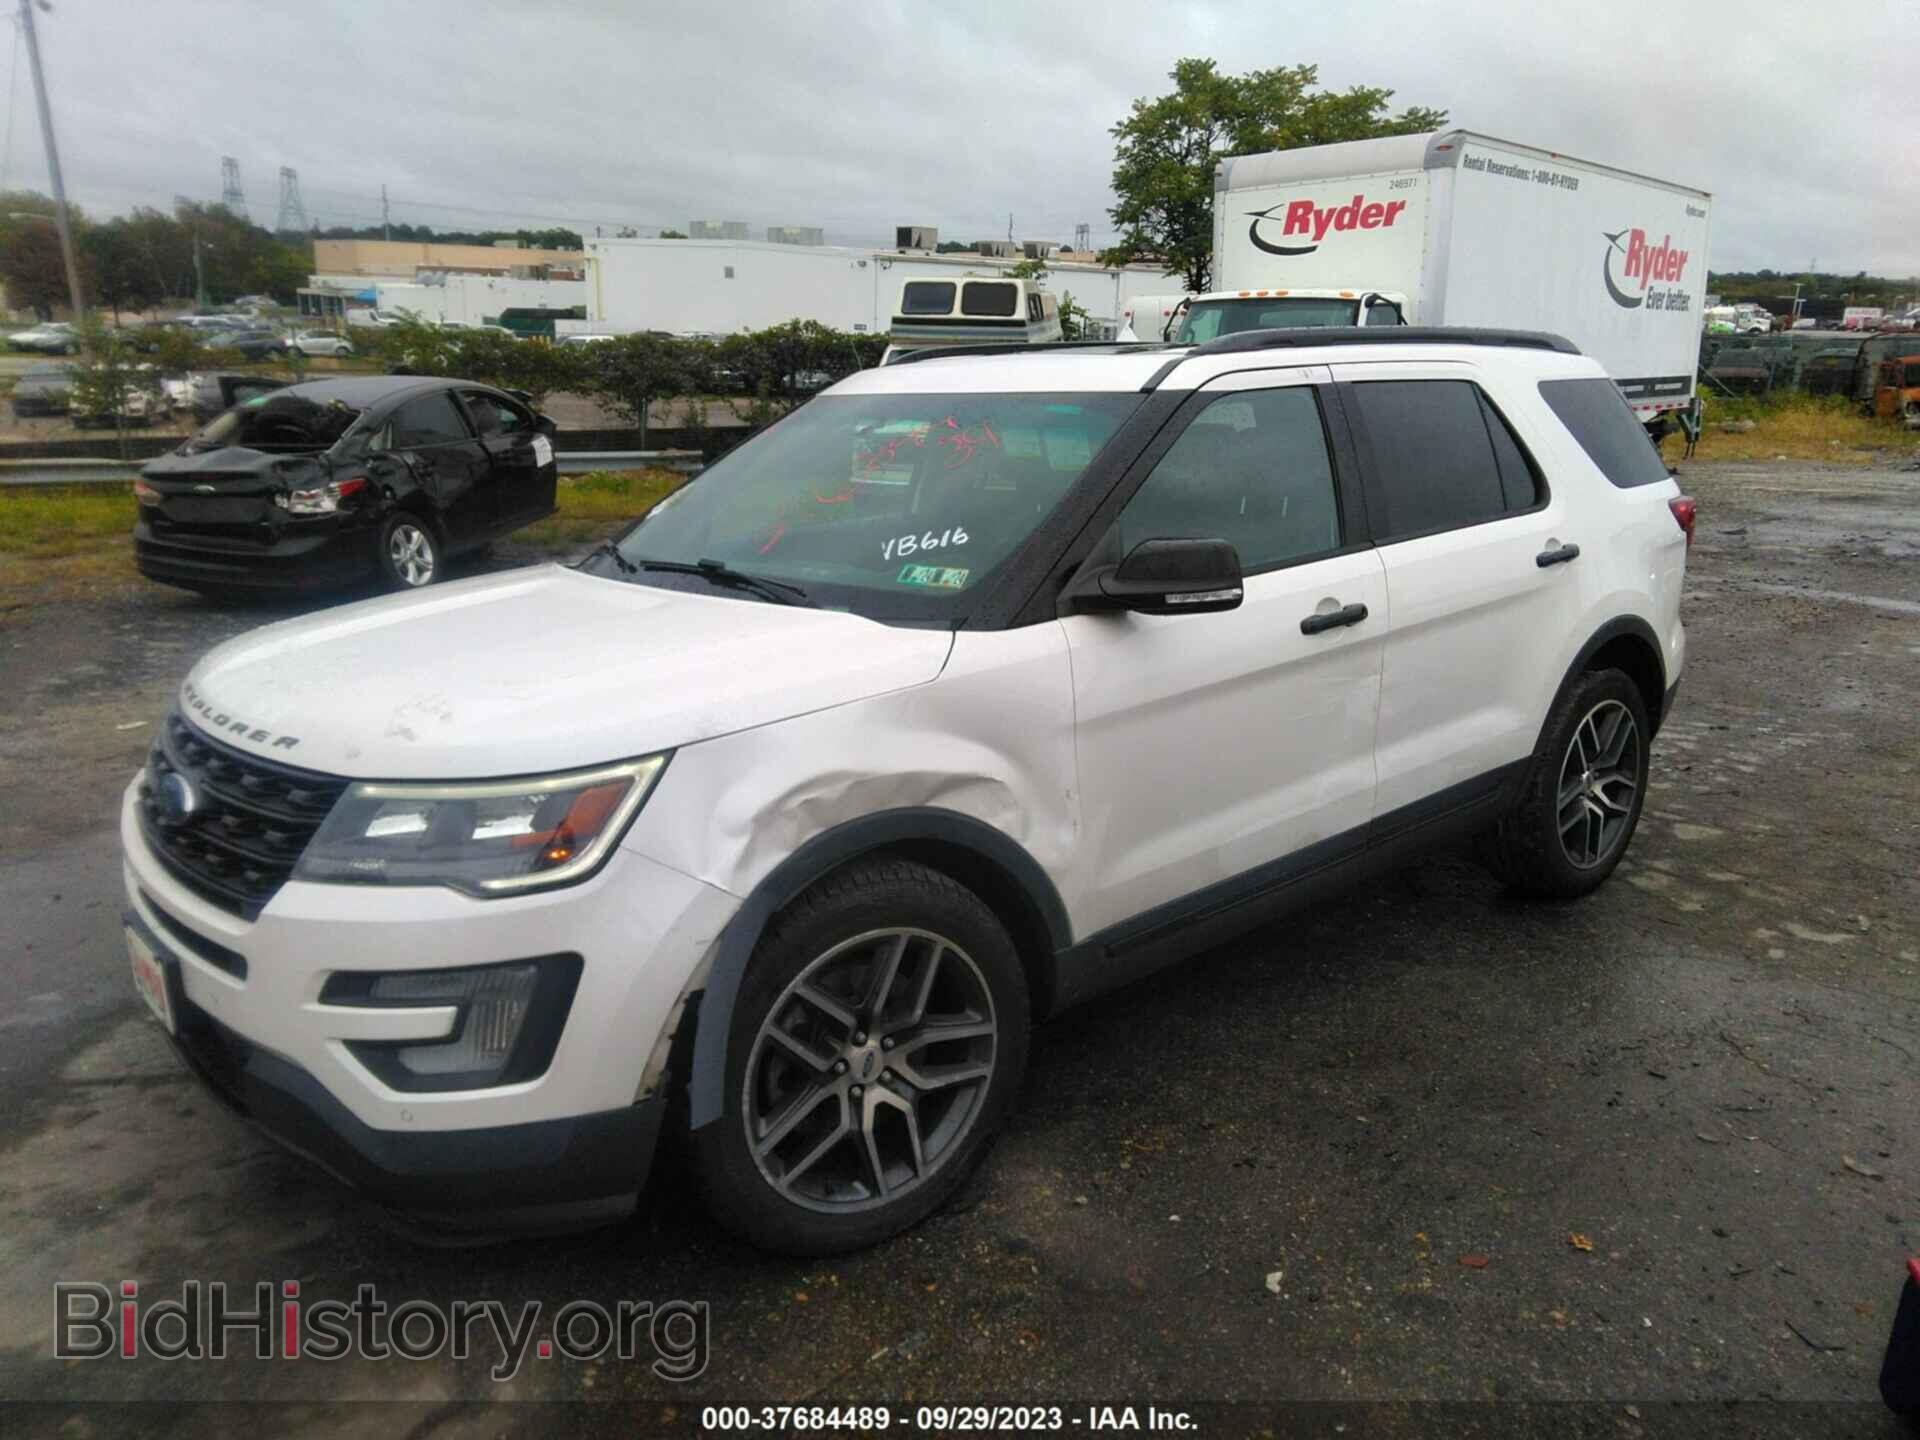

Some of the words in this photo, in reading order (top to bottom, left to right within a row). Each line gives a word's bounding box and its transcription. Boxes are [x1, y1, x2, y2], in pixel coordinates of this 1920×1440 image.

[1463, 154, 1486, 171] Rental
[1487, 159, 1531, 181] Reservations:
[1283, 195, 1406, 241] Ryder
[1624, 228, 1689, 290] Ryder
[1646, 286, 1665, 310] Ever
